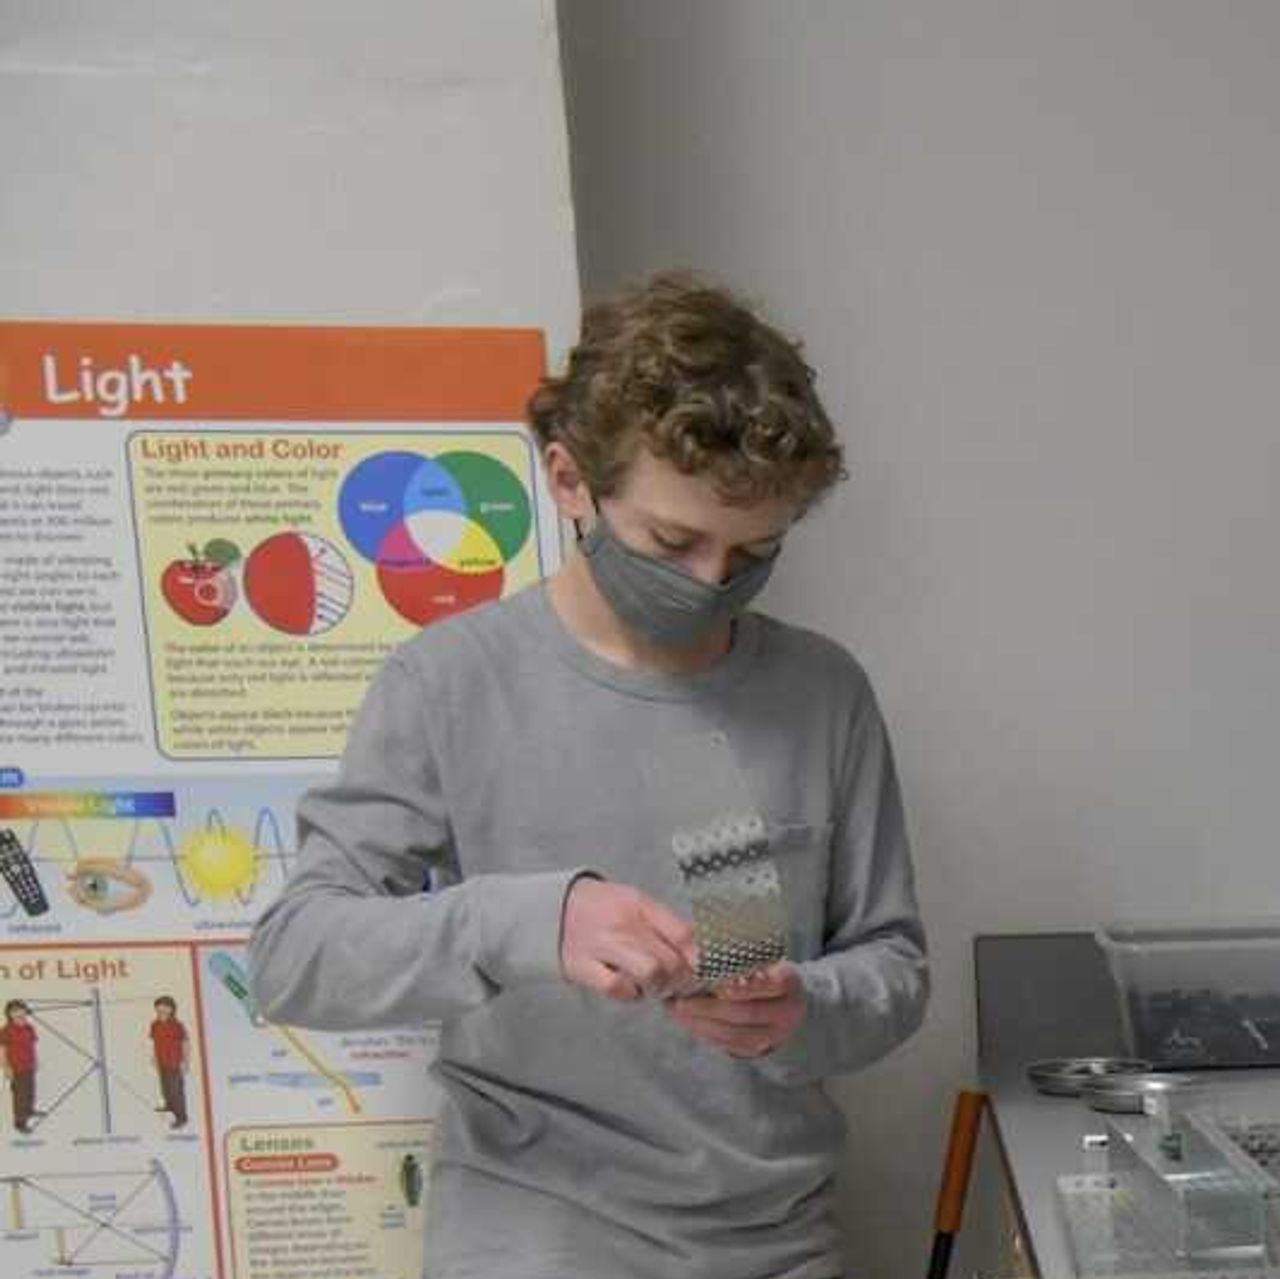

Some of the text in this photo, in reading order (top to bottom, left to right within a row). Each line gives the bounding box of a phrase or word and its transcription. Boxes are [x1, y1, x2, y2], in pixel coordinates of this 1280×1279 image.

[43, 354, 193, 416] Light
[141, 438, 341, 462] Light and Color
[19, 960, 44, 980] of
[57, 959, 130, 982] Light
[240, 1137, 314, 1151] Lenses
